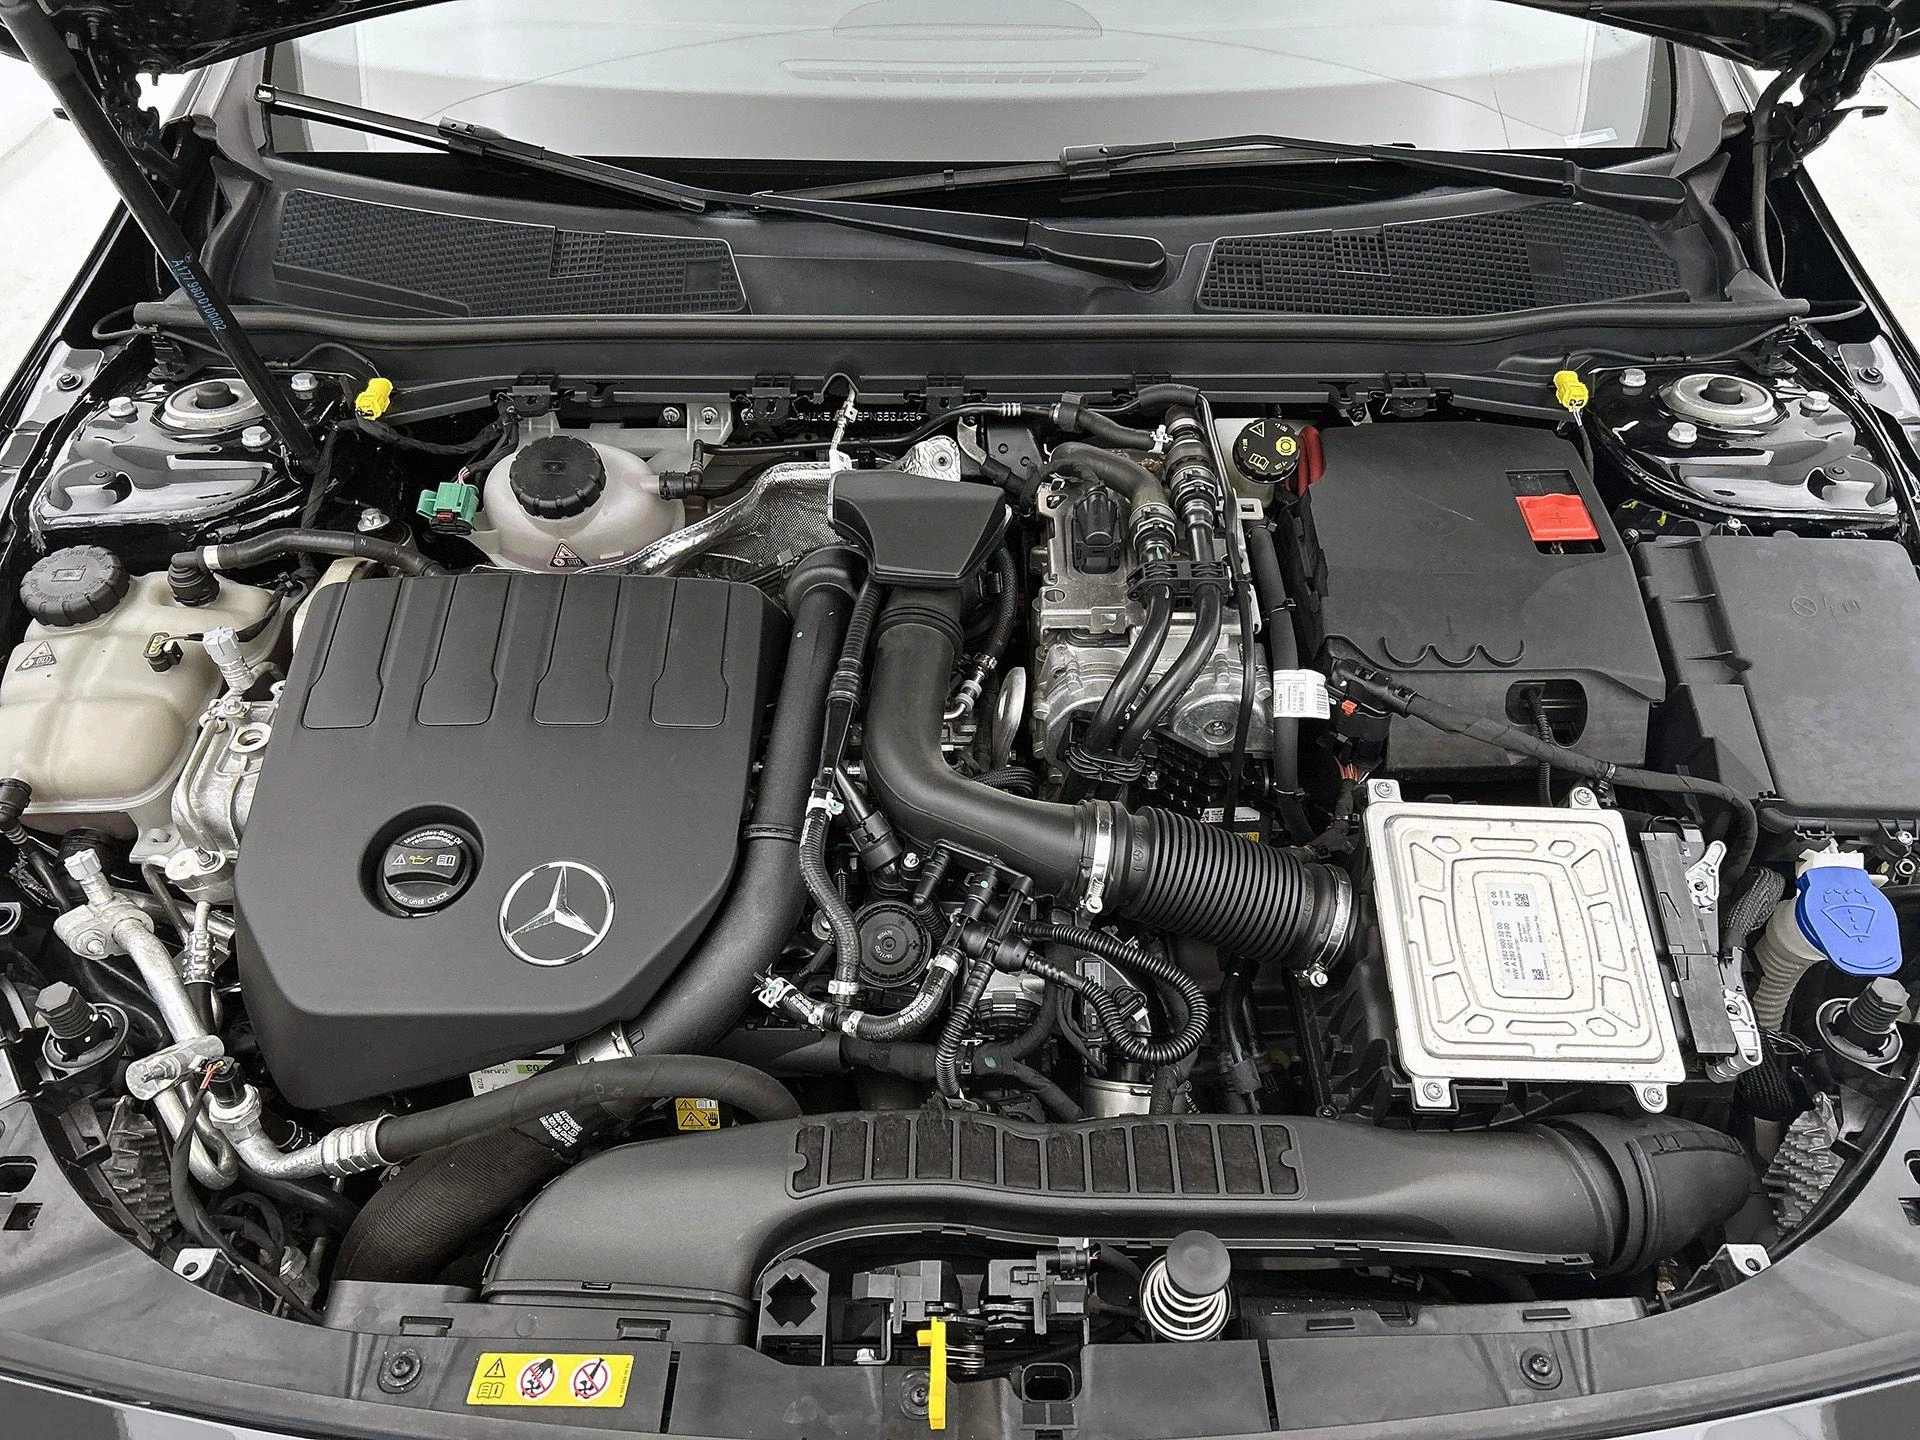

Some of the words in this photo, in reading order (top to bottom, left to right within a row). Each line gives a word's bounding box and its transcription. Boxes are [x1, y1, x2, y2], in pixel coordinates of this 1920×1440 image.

[171, 260, 195, 281] A177
[187, 281, 205, 298] 980
[403, 830, 455, 845] Mercedes-Benz
[411, 836, 455, 846] recommended
[394, 890, 408, 902] Turn
[427, 891, 450, 904] CLICK
